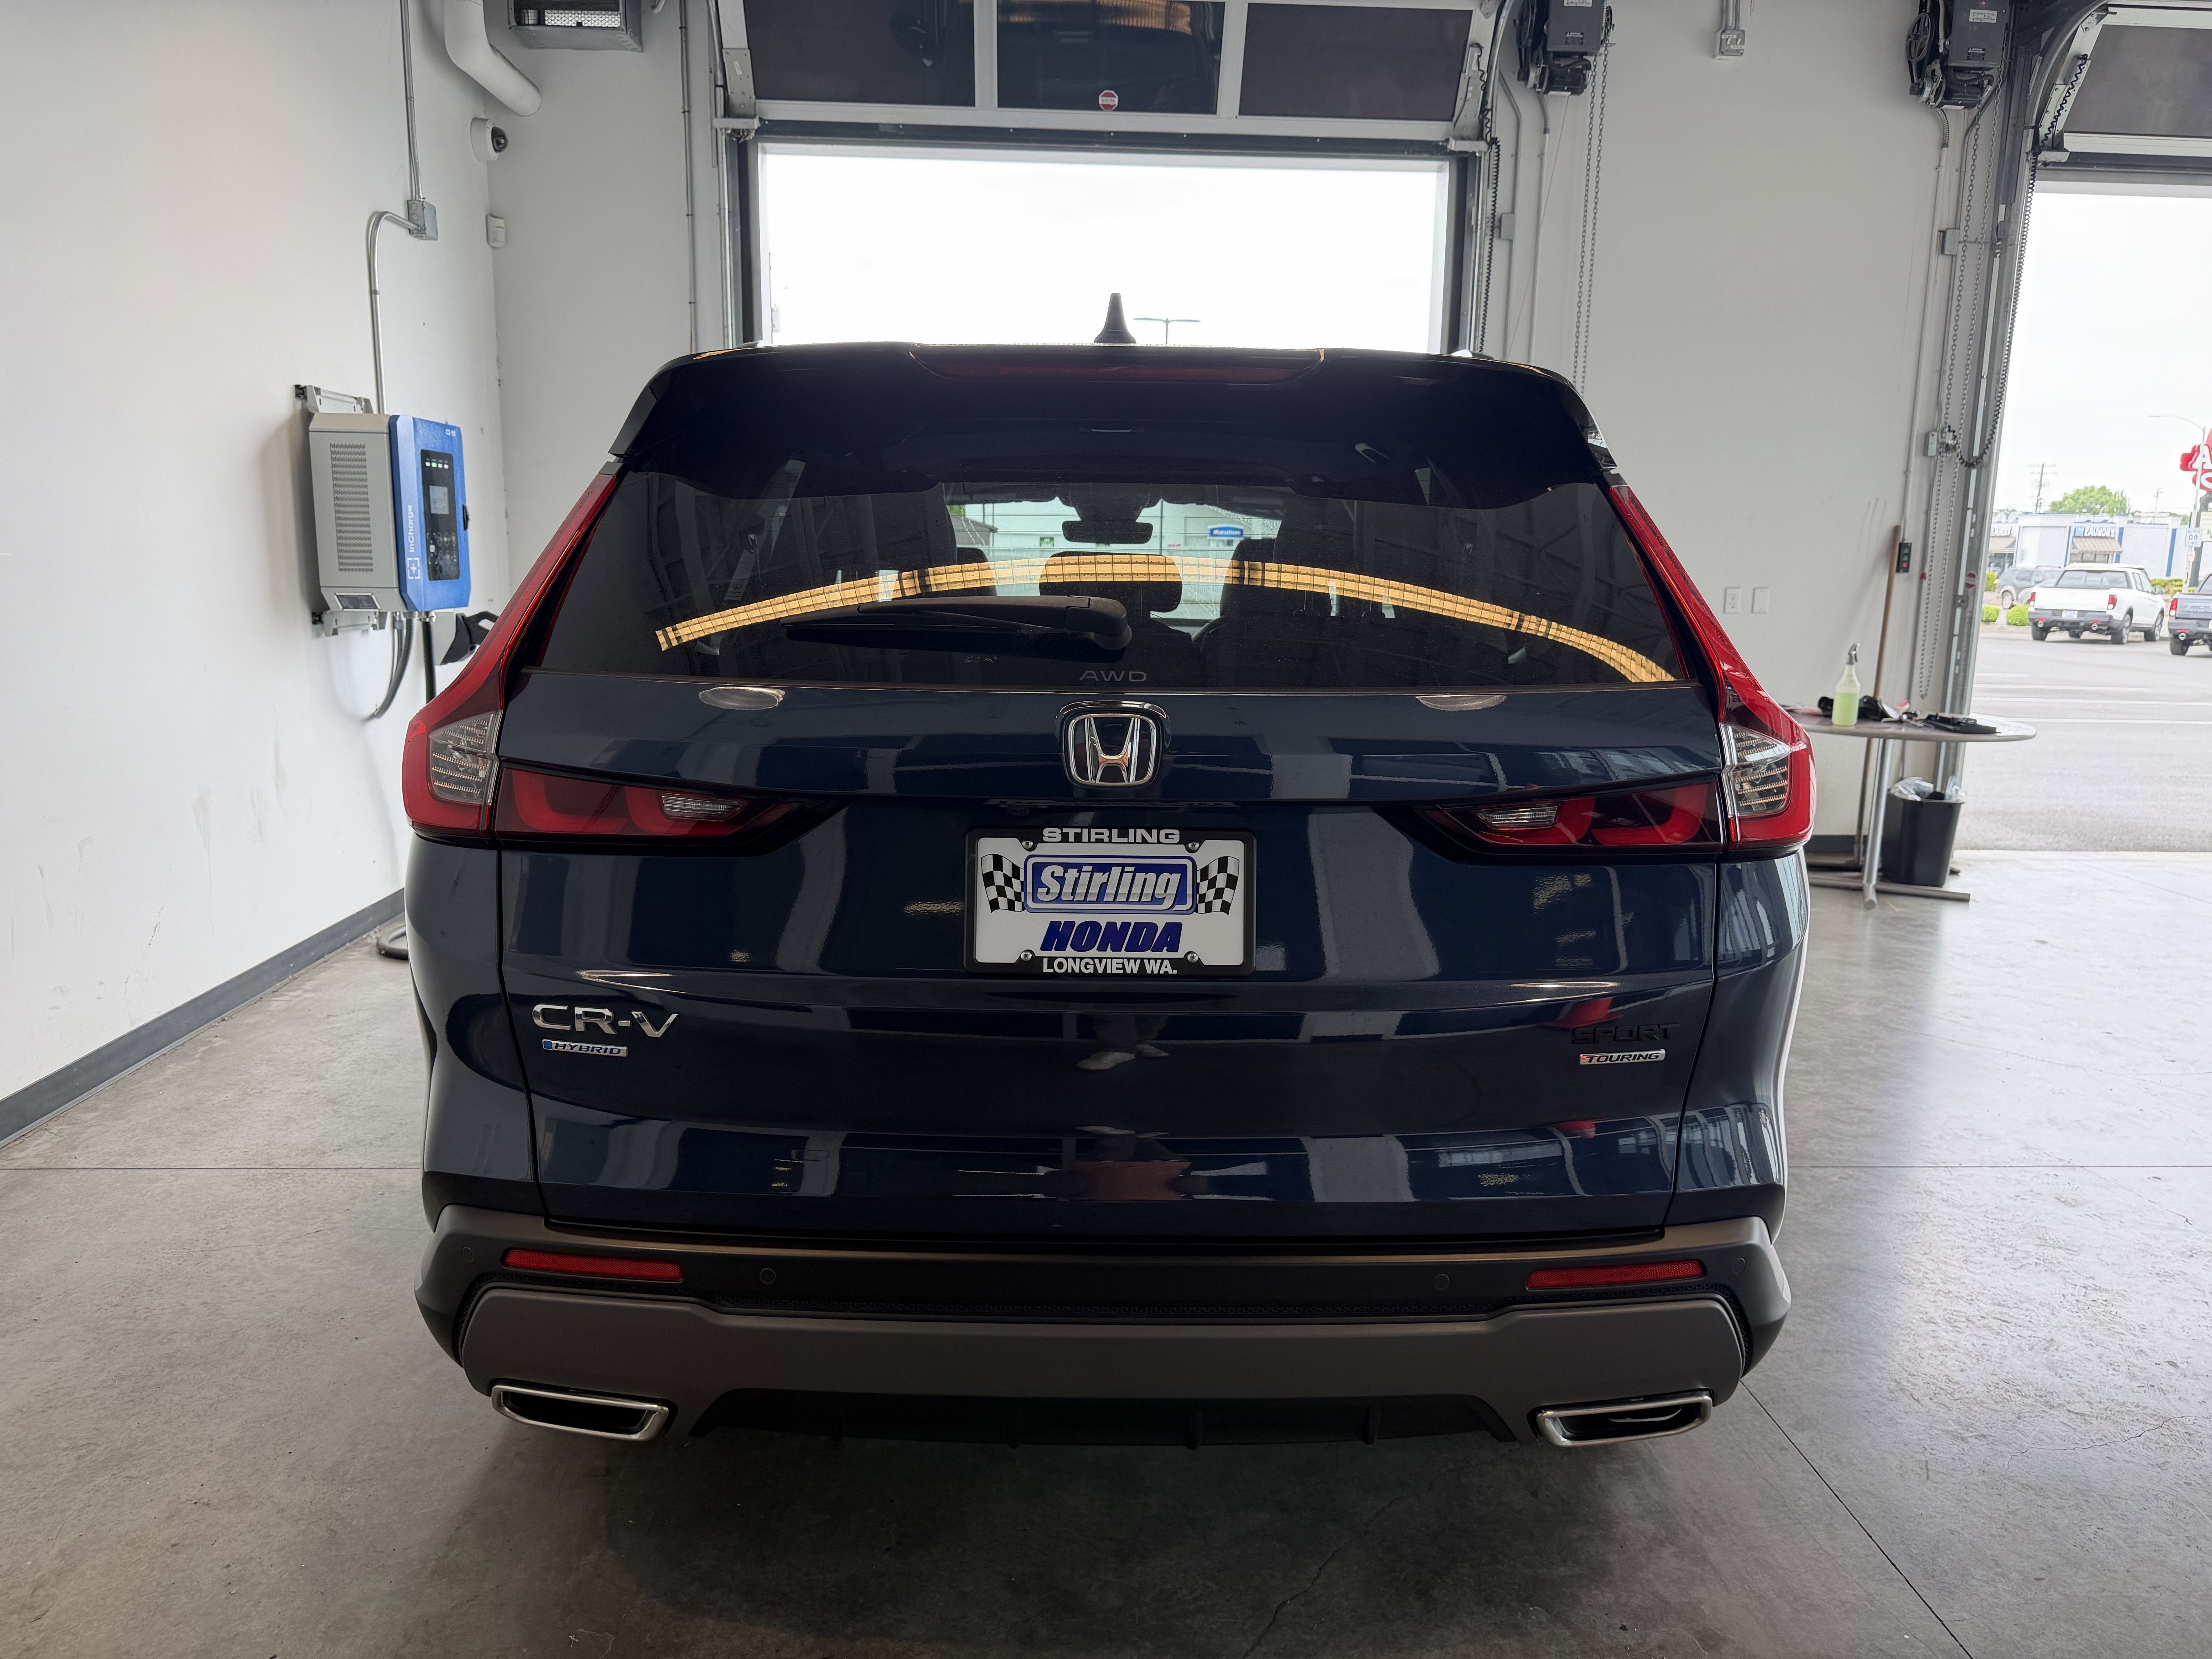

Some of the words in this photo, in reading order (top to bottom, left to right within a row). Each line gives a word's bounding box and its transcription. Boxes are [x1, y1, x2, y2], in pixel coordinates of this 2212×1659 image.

[2084, 526, 2115, 537] LAUNDRY
[1079, 670, 1147, 682] AWD
[1042, 828, 1180, 843] STIRLING
[1037, 865, 1181, 911] Stirling
[1039, 921, 1183, 953] HONDA
[1043, 958, 1140, 973] LONGVIEW
[1143, 959, 1177, 974] WA.
[532, 1004, 679, 1037] CR-V
[1571, 1024, 1680, 1044] SPORT
[554, 1042, 621, 1055] HYBRID
[1586, 1053, 1660, 1063] TOURING
